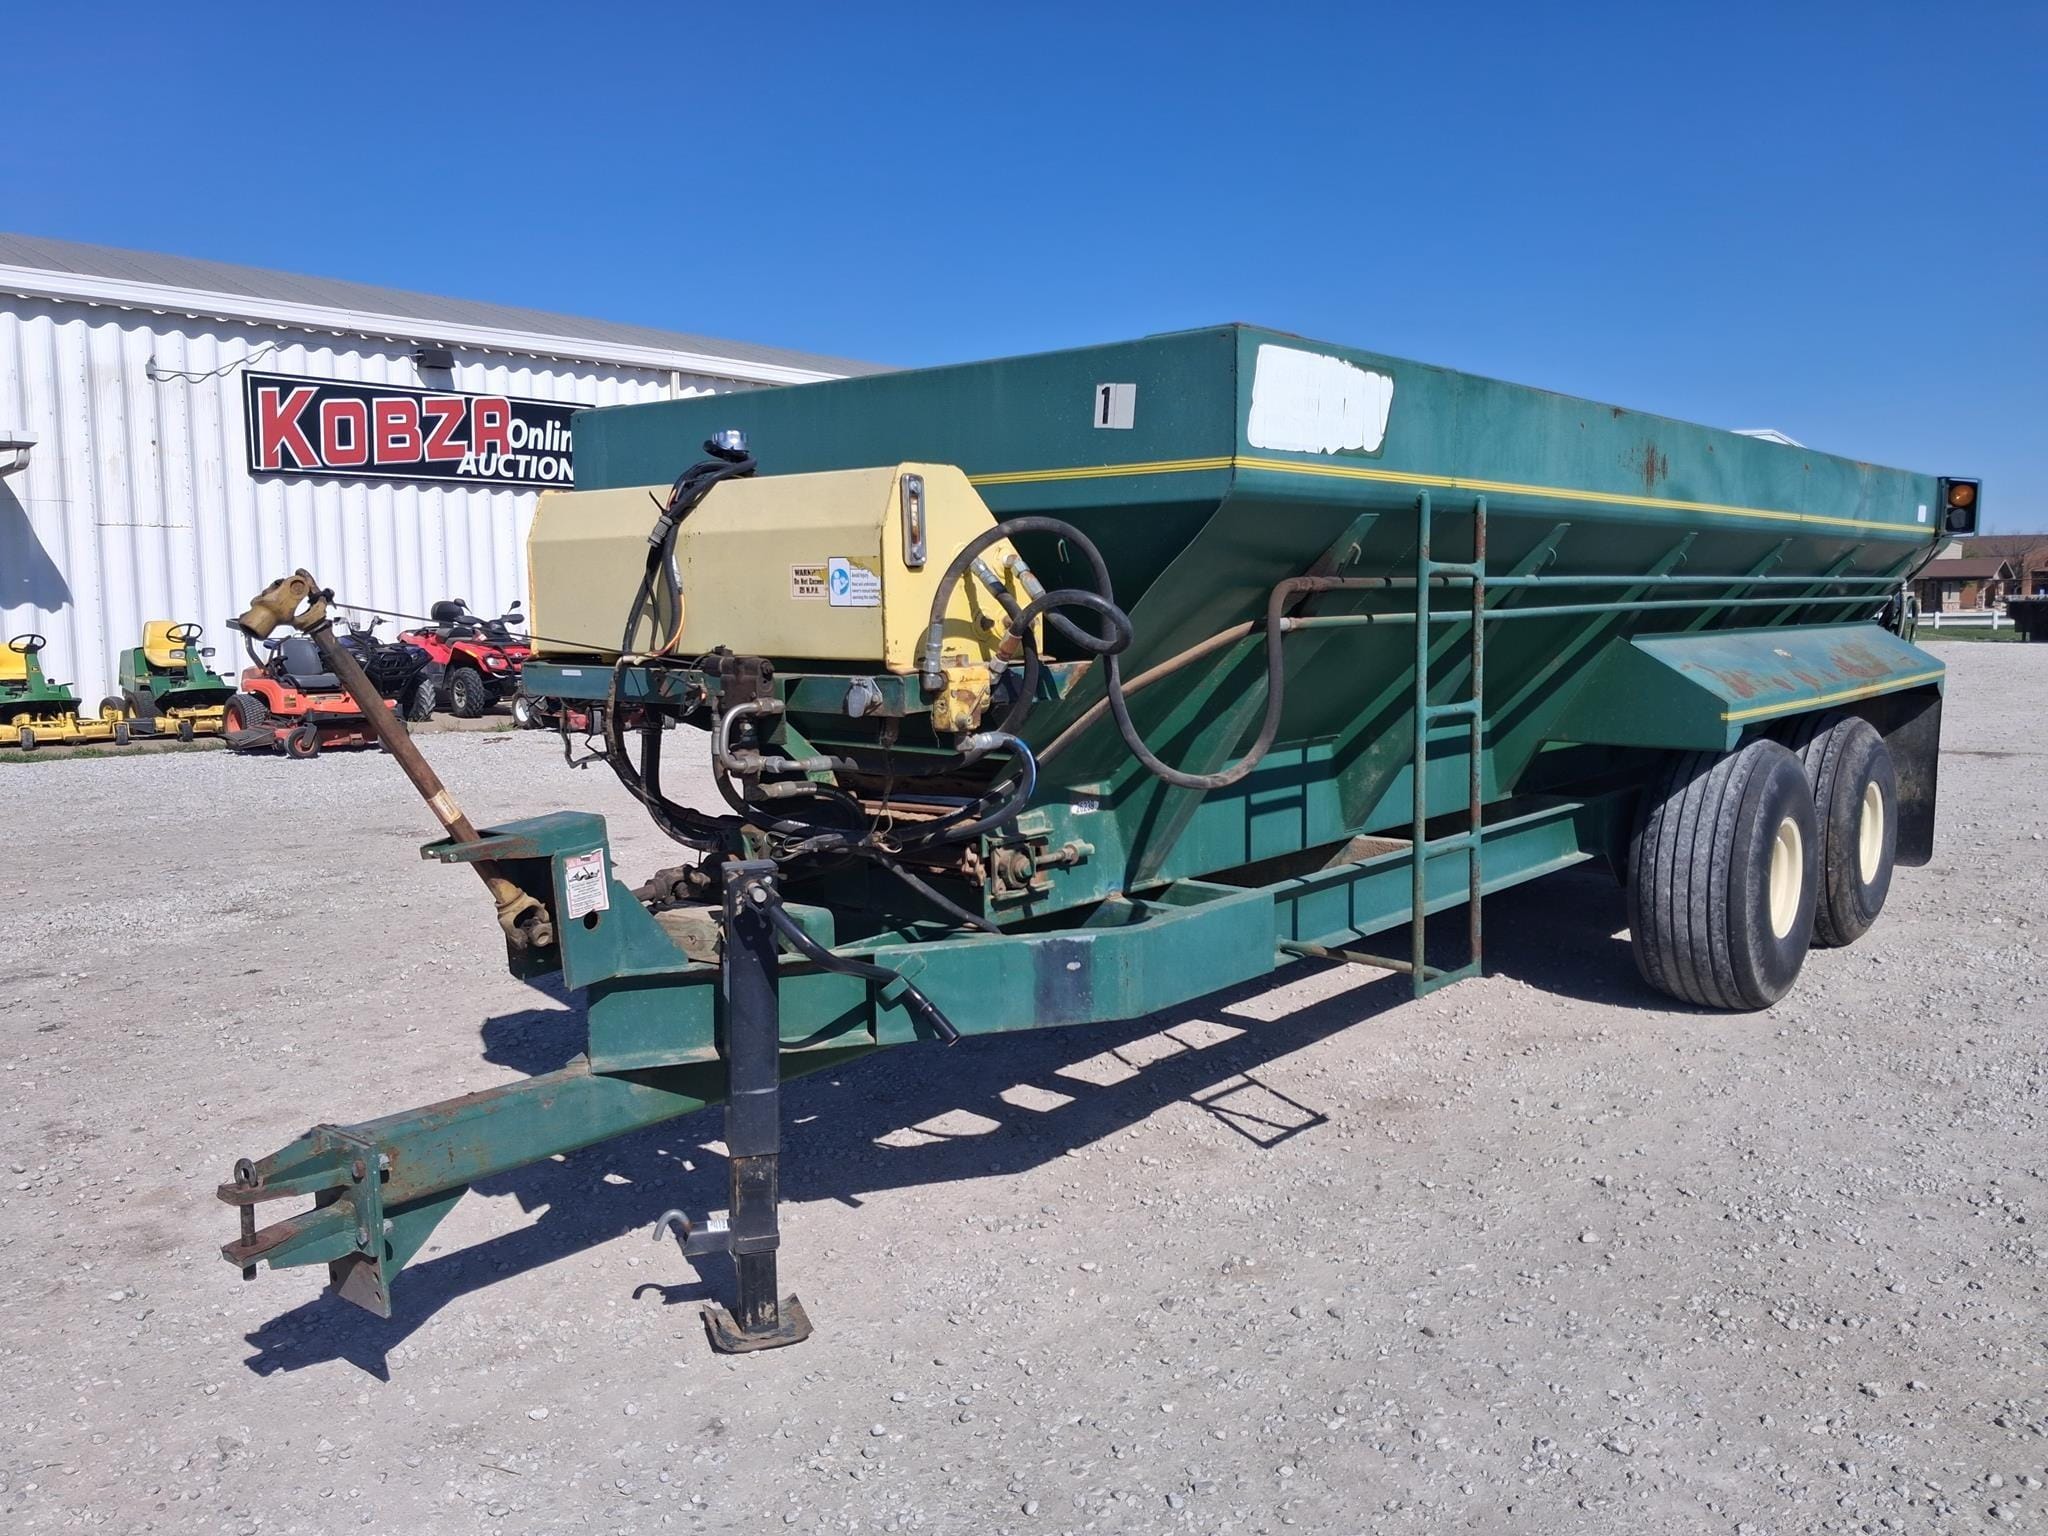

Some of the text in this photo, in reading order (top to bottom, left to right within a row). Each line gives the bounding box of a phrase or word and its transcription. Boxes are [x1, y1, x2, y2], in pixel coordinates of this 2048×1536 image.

[1101, 386, 1110, 425] 1
[257, 386, 511, 470] KOBZA
[506, 418, 573, 452] Onlin
